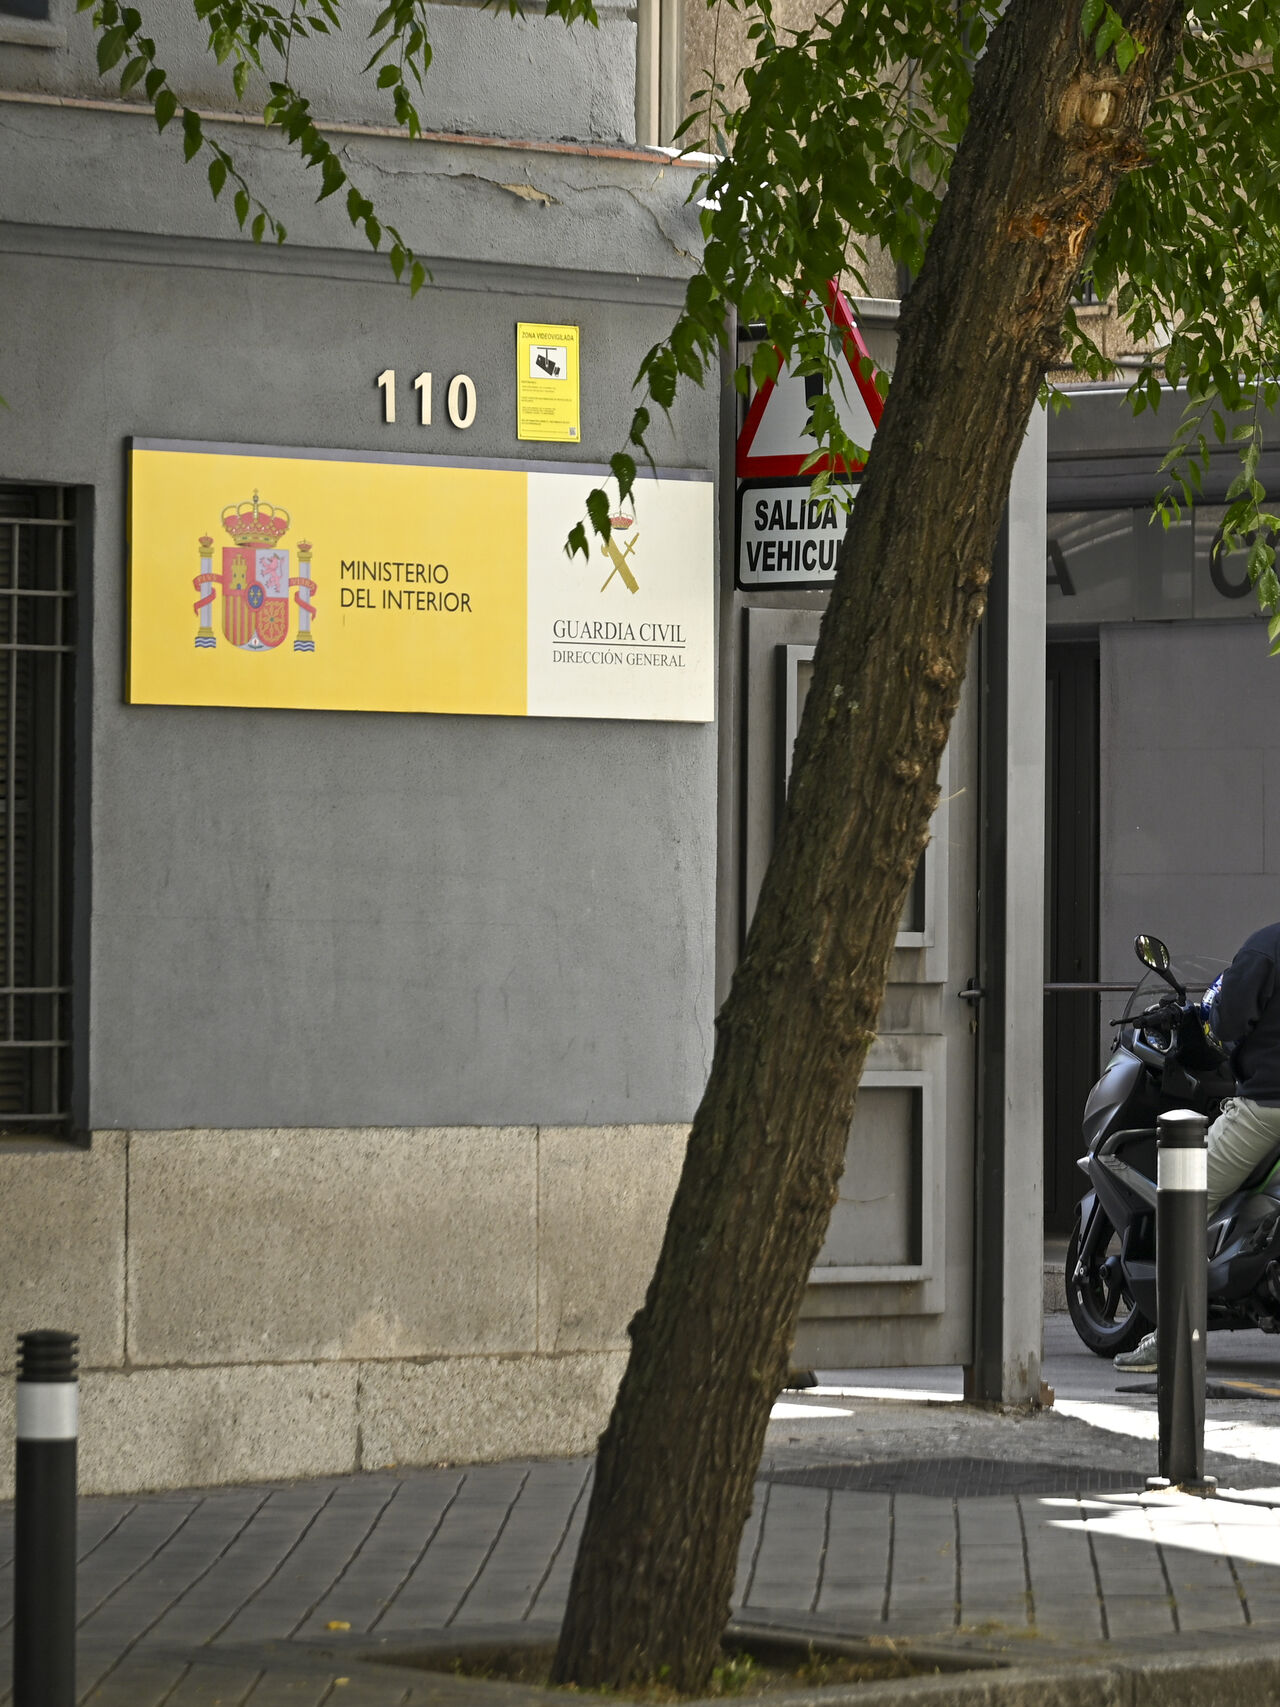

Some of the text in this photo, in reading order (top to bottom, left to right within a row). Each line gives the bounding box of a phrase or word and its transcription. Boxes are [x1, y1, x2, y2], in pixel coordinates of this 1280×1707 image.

[377, 369, 477, 429] 110
[754, 499, 838, 531] SALIDA
[340, 559, 449, 584] MINISTERIO
[340, 587, 472, 613] DEL INTERIOR
[553, 619, 687, 643] GUARDIA CIVIL
[553, 649, 686, 668] DIRECCIÓN GENERAL
